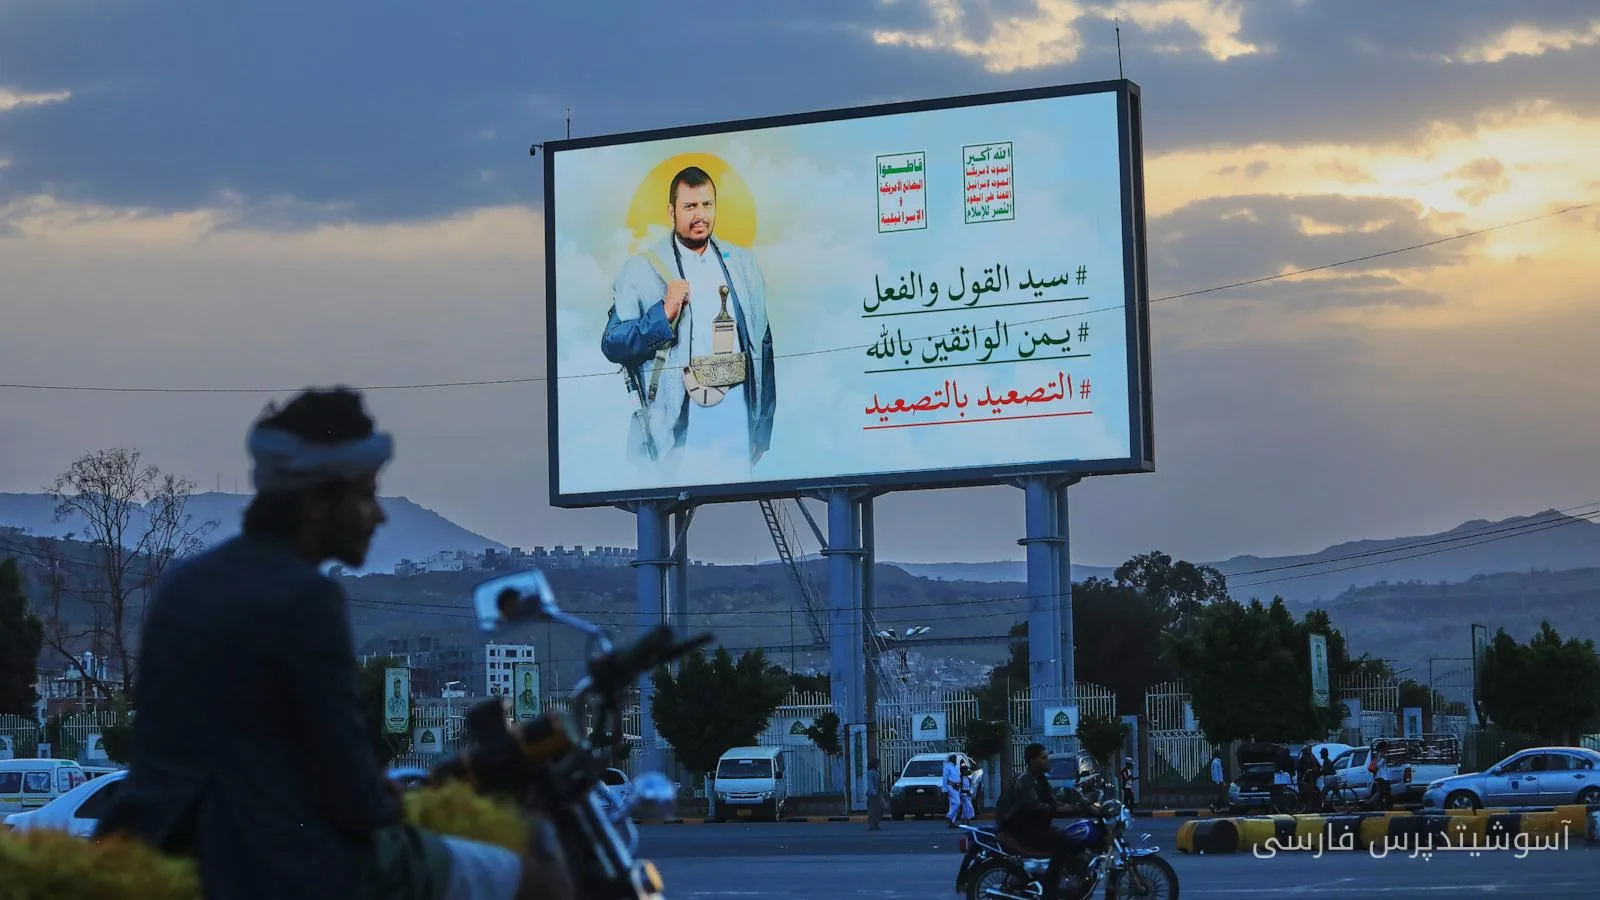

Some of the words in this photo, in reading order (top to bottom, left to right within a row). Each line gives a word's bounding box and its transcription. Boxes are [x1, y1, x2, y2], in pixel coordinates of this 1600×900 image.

[879, 158, 923, 177] قاطعوا
[966, 146, 992, 165] أكبر
[994, 147, 1011, 160] الله
[992, 202, 1012, 218] النصر
[863, 270, 939, 312] والفعل
[948, 263, 1009, 306] القول
[866, 323, 912, 366] بالله
[922, 320, 1009, 363] الواثقين
[865, 380, 968, 422] بالتصعيد
